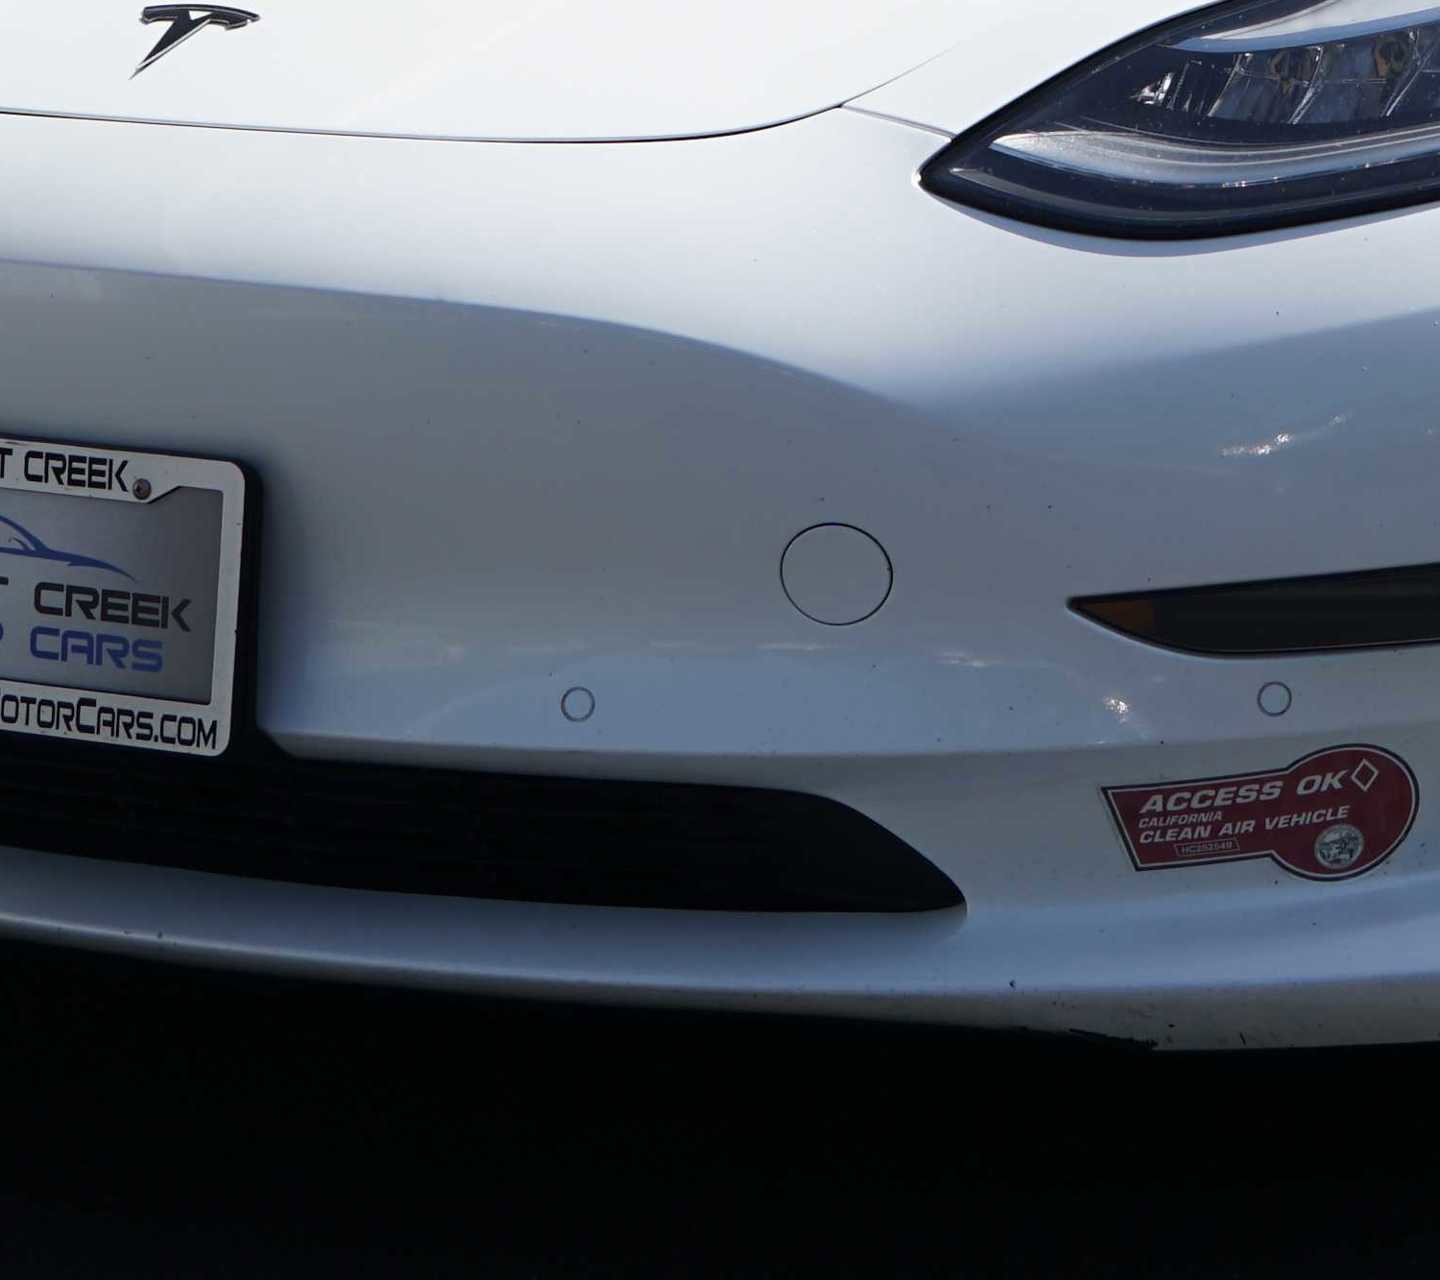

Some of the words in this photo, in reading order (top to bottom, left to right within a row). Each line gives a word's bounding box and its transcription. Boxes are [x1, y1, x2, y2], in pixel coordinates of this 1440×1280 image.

[23, 451, 129, 493] CREEK
[33, 582, 192, 632] CREEK
[30, 625, 163, 673] CARS
[1139, 781, 1284, 814] ACCESS
[1296, 769, 1348, 795] OK
[1138, 811, 1222, 828] CALIFORNIA
[1139, 824, 1212, 844] CLEAN
[1218, 820, 1256, 837] AIR
[1264, 805, 1351, 831] VEHICLE
